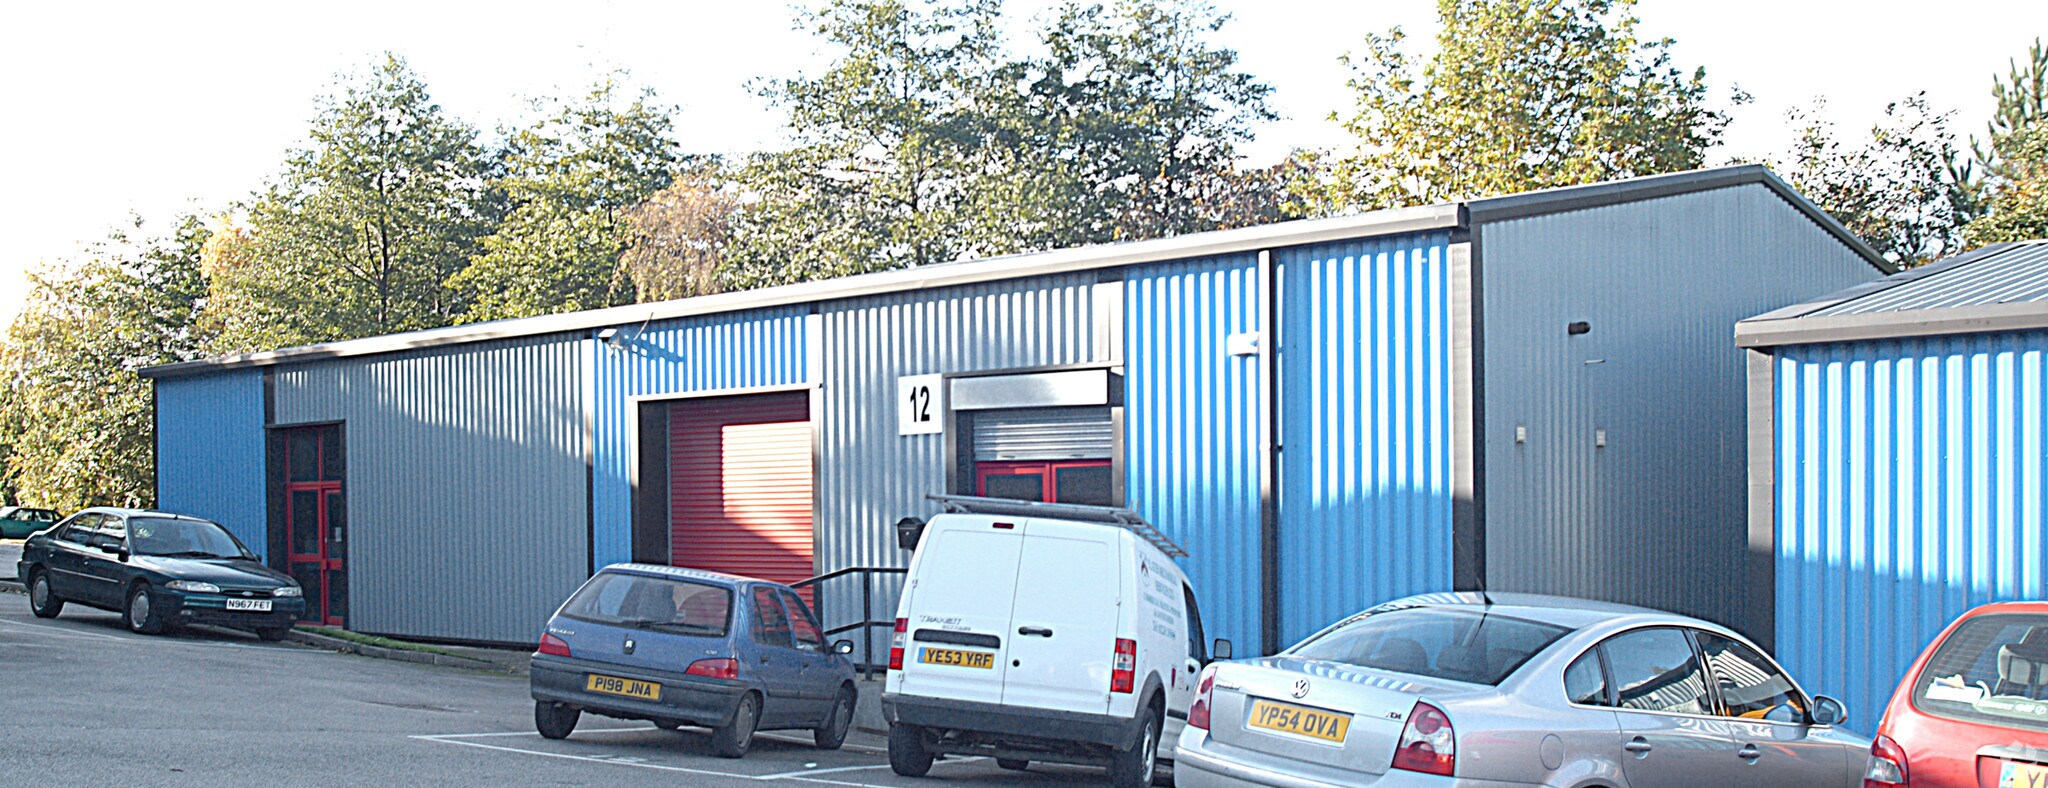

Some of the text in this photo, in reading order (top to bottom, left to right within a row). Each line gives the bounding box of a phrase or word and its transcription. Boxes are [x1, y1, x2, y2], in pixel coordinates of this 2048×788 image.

[910, 385, 930, 423] 12
[228, 600, 270, 609] N967 FET
[927, 649, 993, 666] YE53 YRF
[594, 677, 651, 697] P198 JNA
[1259, 704, 1338, 738] YP54 OVA
